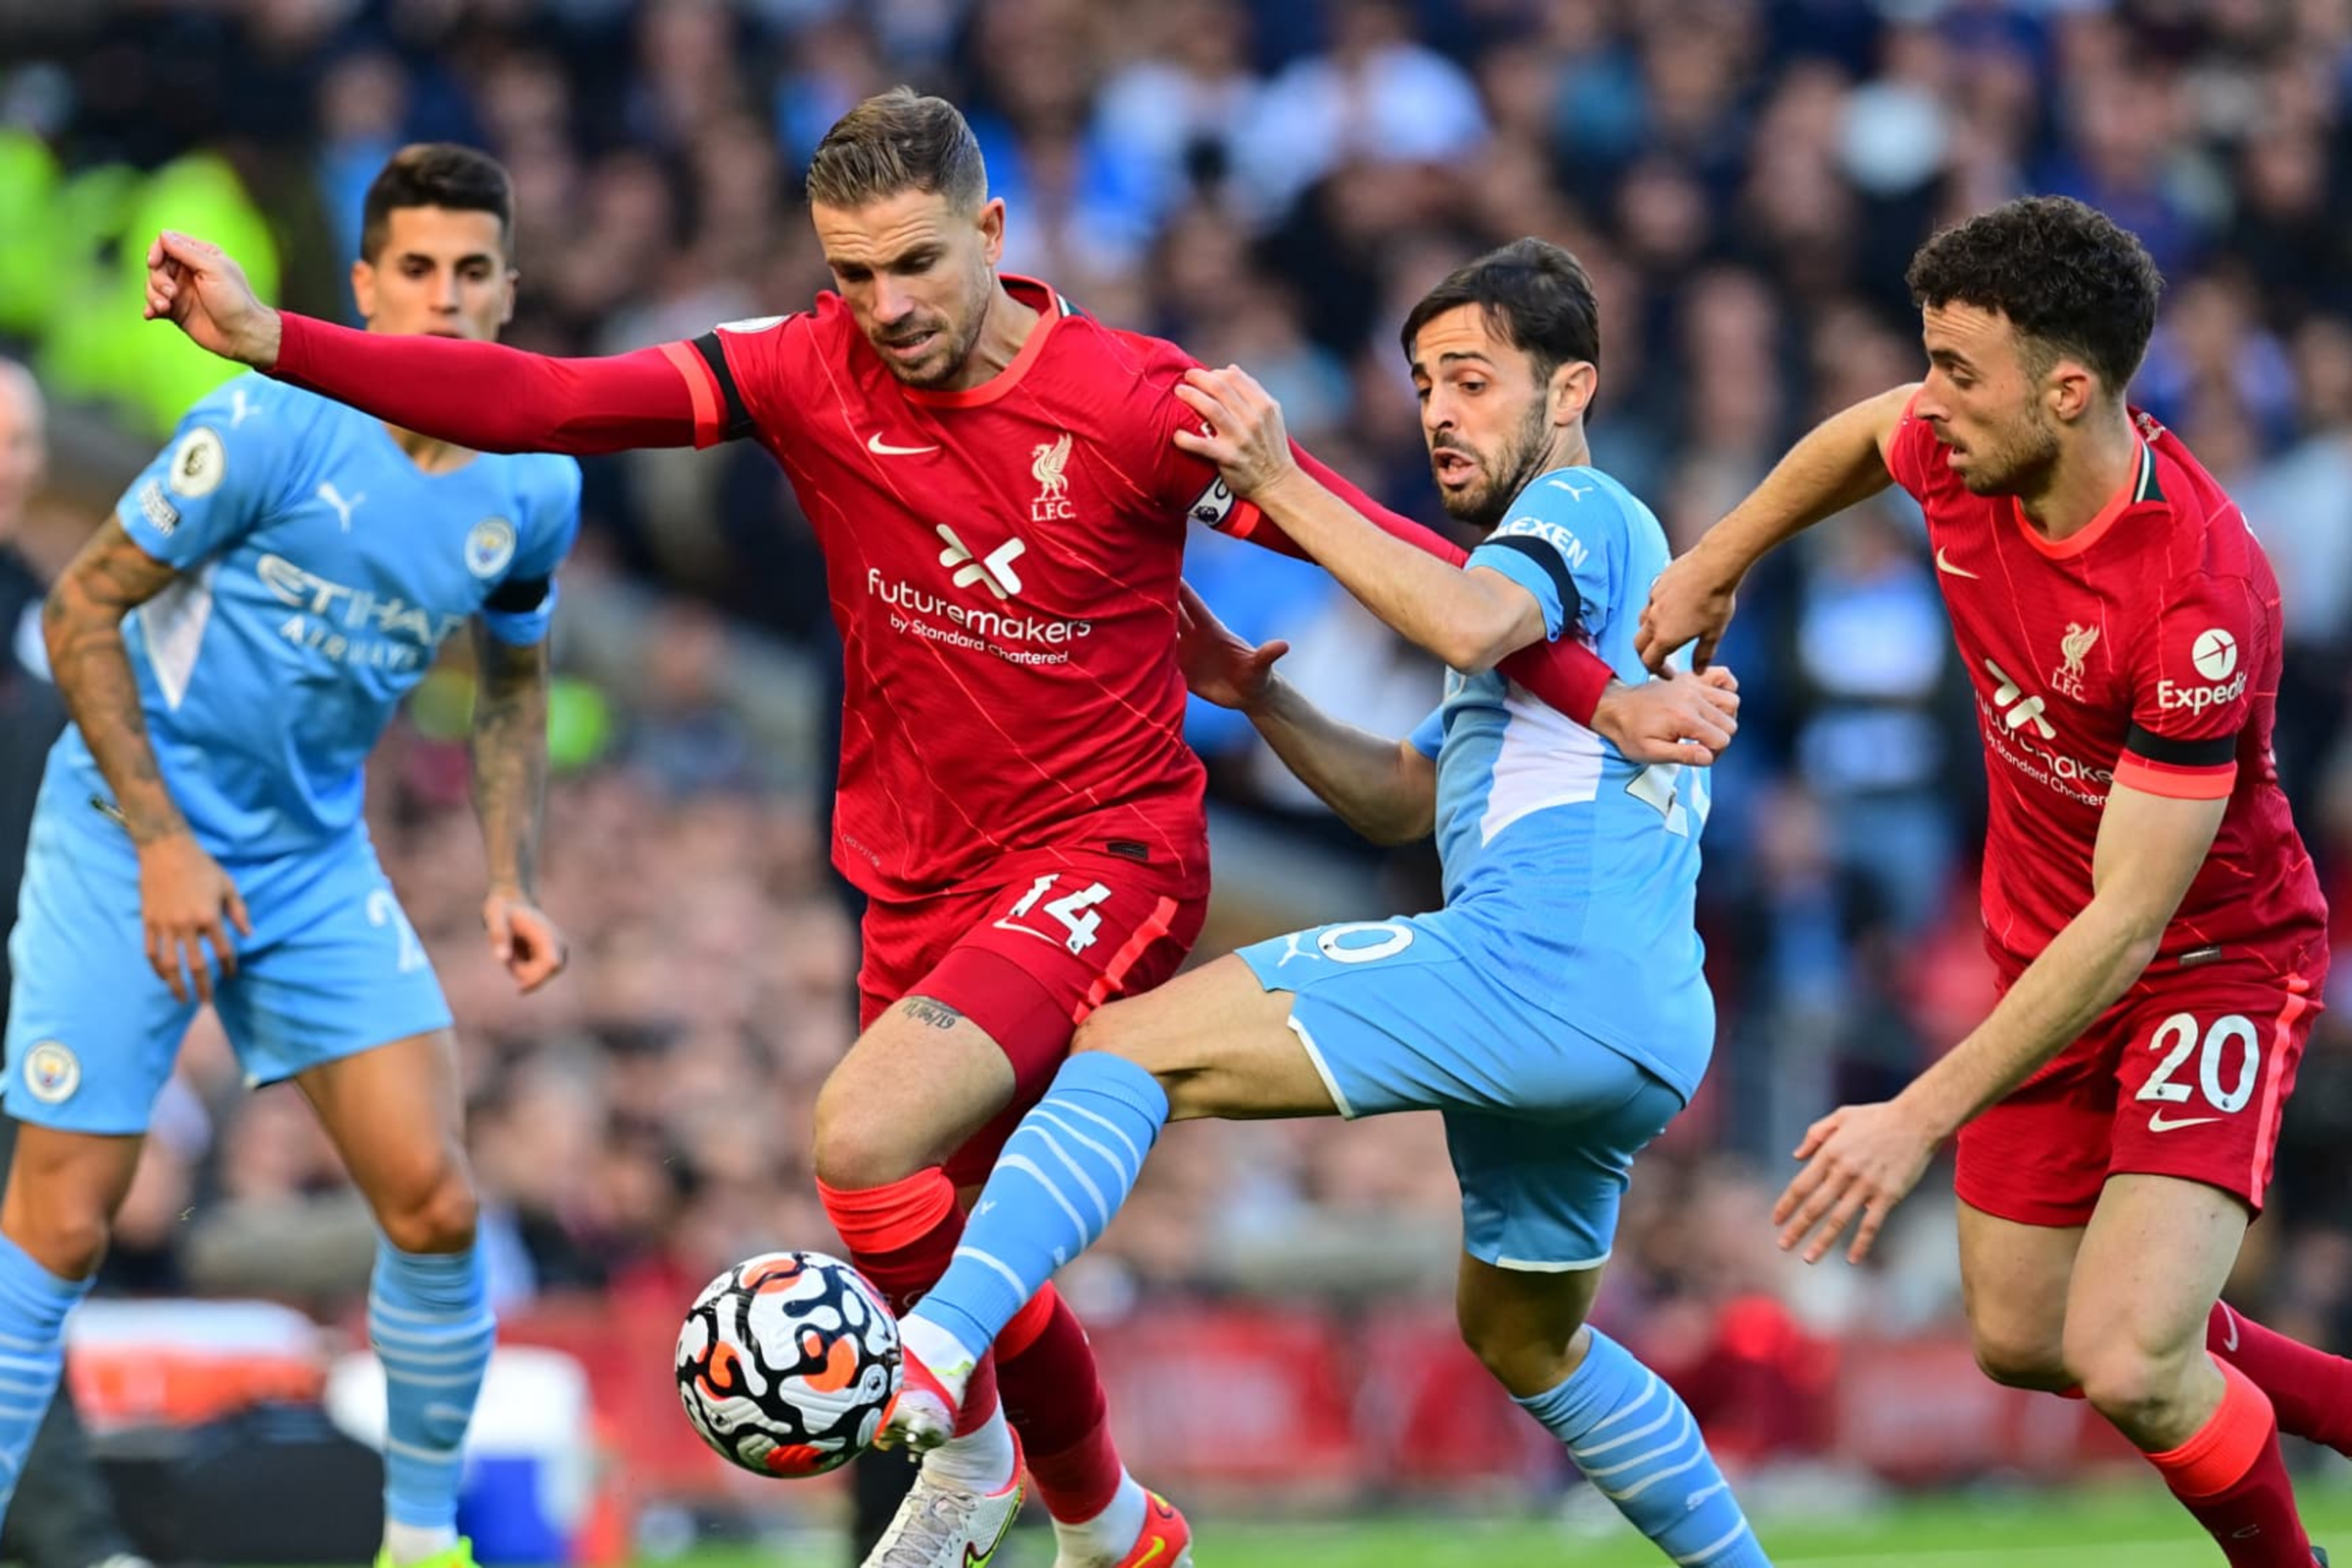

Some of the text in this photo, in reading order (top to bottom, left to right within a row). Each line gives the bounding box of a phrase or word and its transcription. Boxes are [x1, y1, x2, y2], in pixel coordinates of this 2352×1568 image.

[891, 612, 1068, 664] by Standard Chartered
[2051, 776, 2109, 806] Charter
[1008, 873, 1111, 956] 14
[2134, 1012, 2260, 1113] 20
